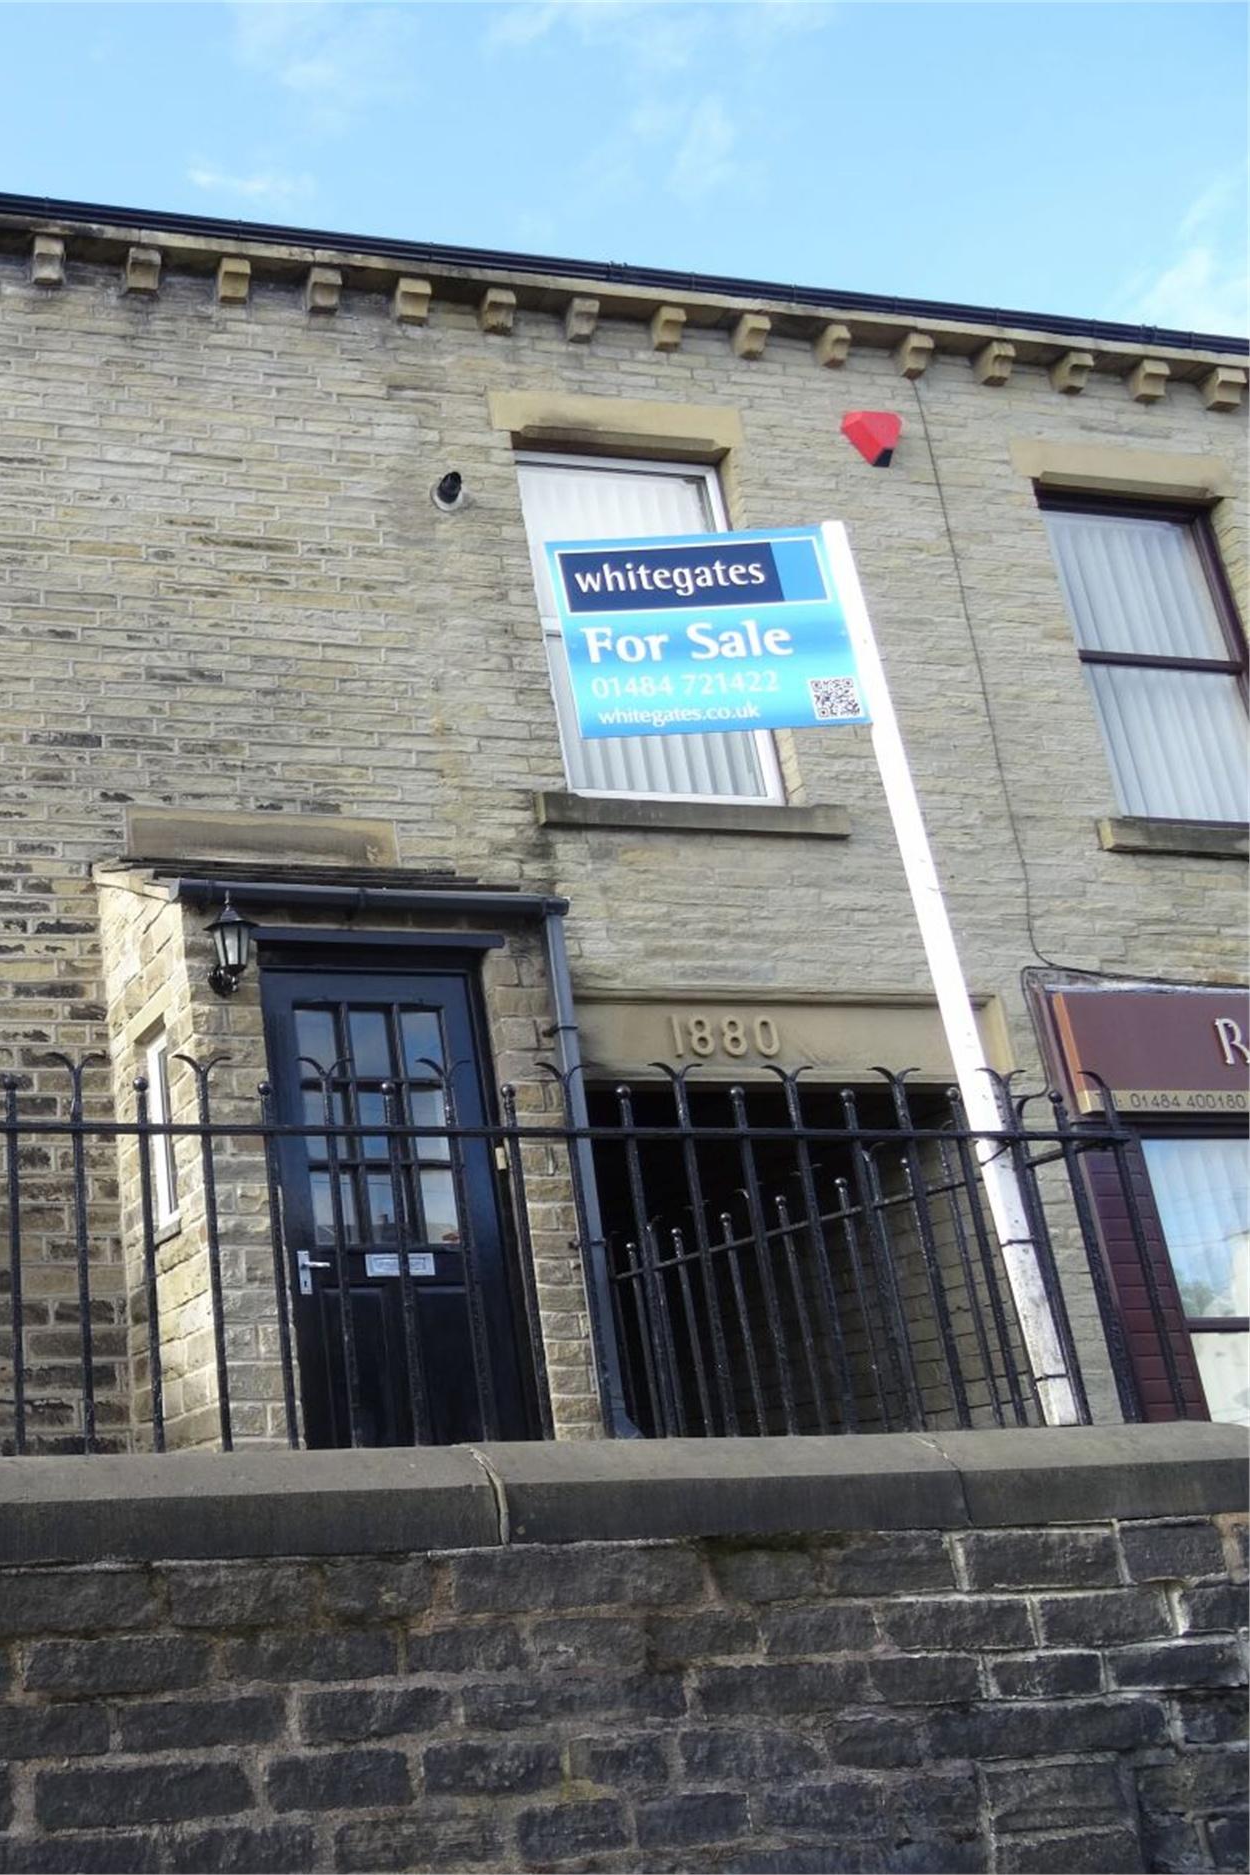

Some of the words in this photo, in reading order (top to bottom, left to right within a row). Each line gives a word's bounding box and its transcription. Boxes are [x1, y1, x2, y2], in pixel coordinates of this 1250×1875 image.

[575, 560, 765, 596] whitegates
[580, 625, 670, 663] For
[686, 619, 794, 660] Sale
[591, 676, 673, 699] 01484
[682, 670, 778, 696] 721422
[598, 701, 761, 727] whitegates.co.uk
[670, 1014, 780, 1058] 1880
[1130, 1093, 1180, 1108] 01484
